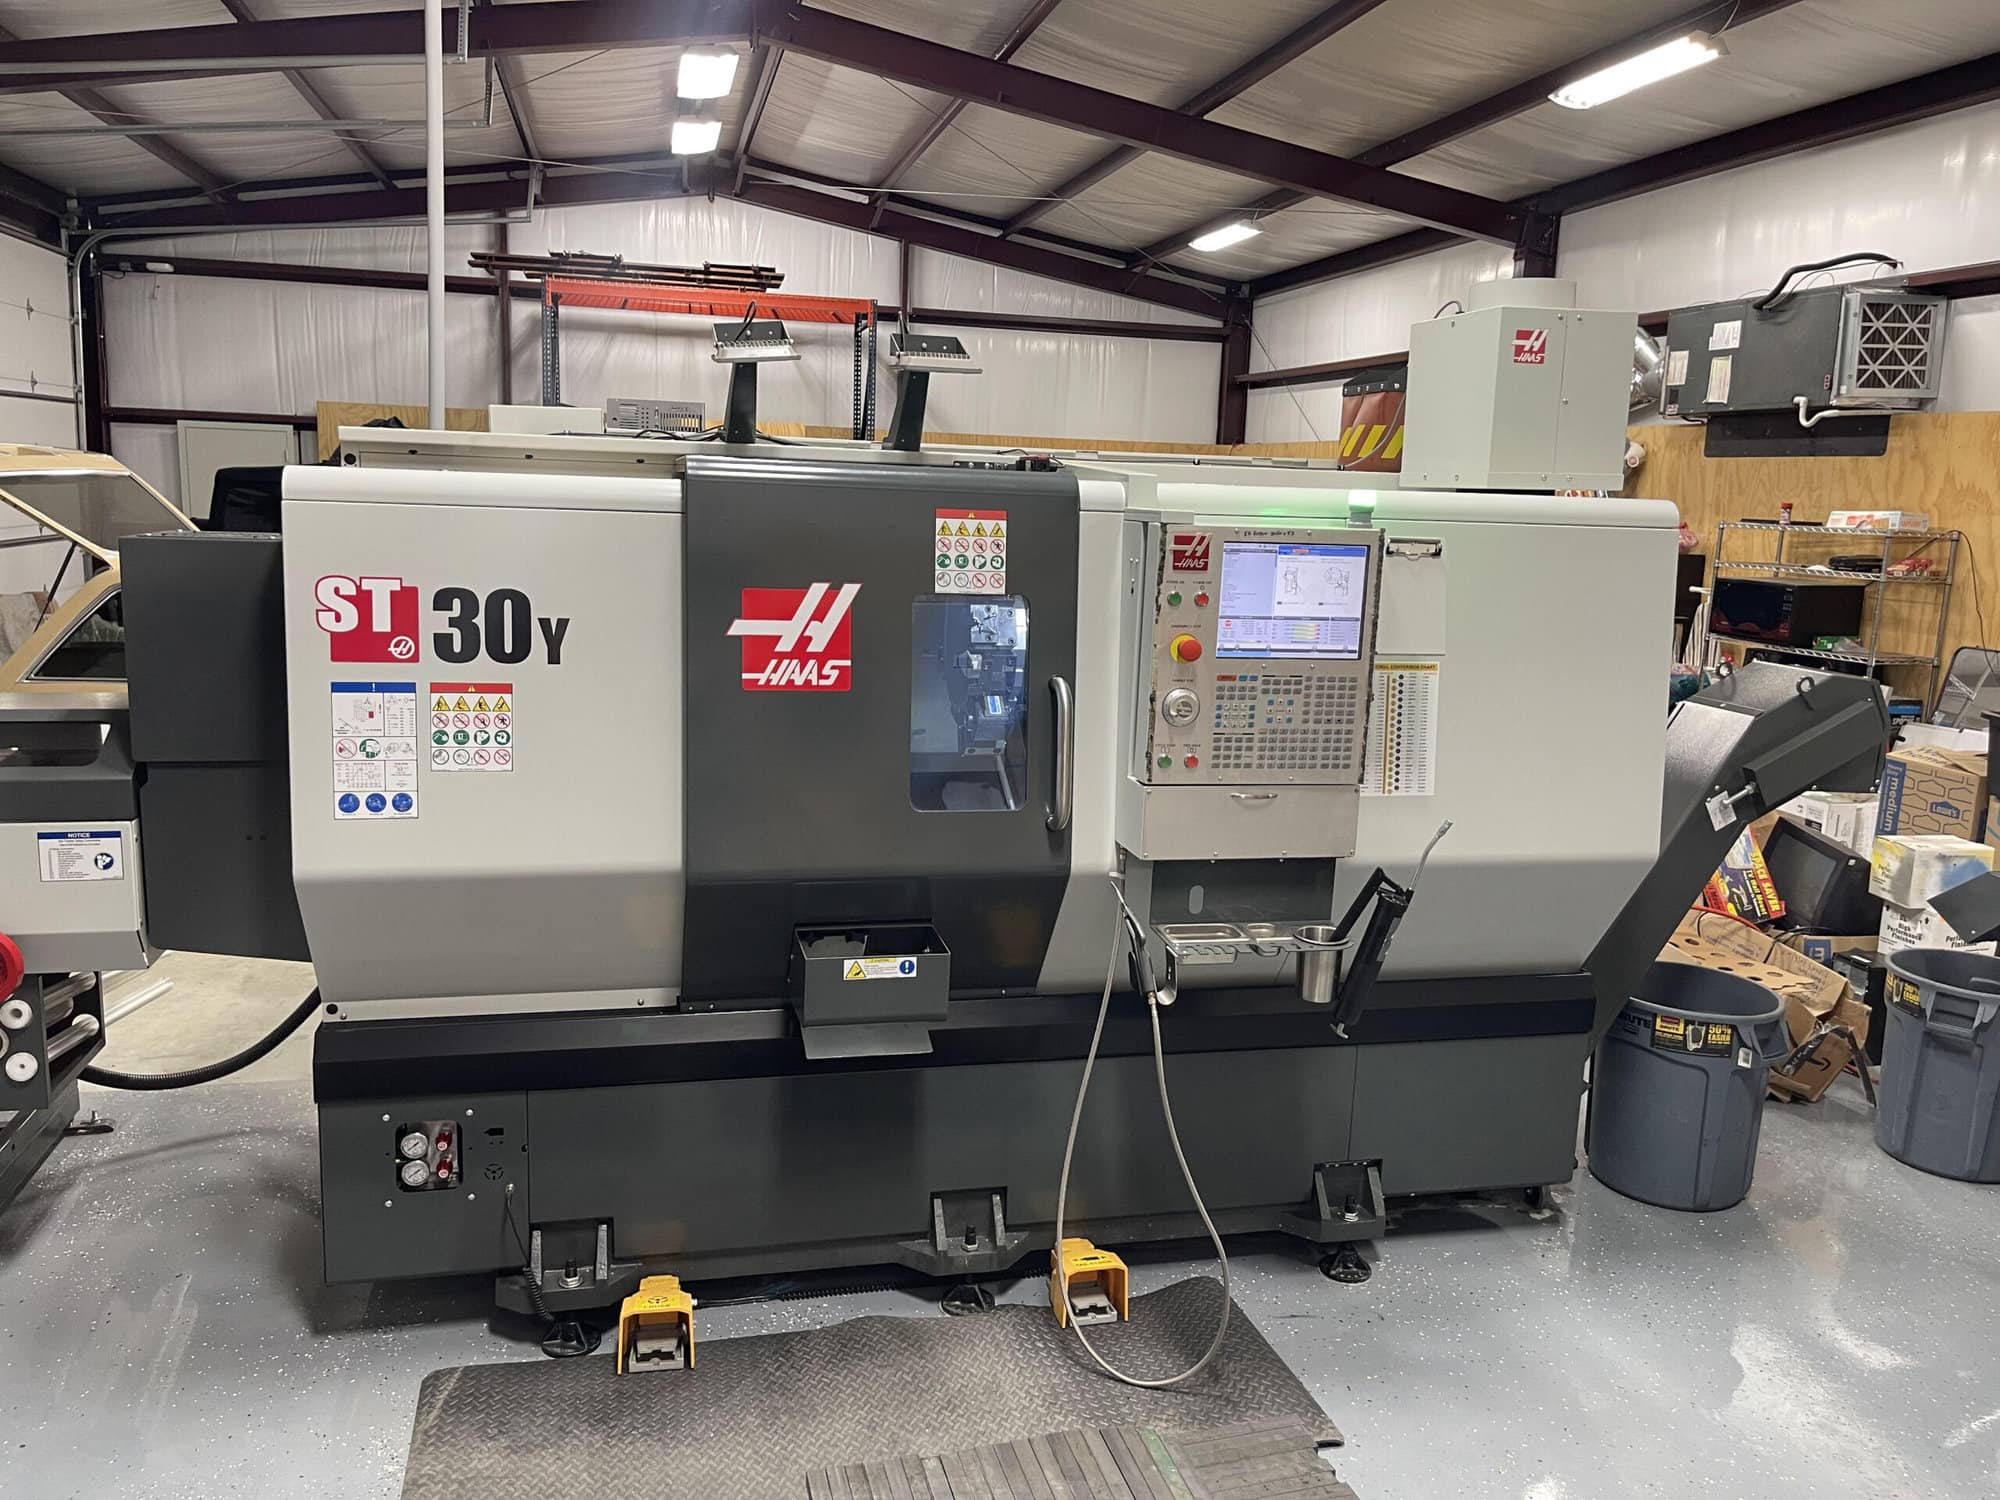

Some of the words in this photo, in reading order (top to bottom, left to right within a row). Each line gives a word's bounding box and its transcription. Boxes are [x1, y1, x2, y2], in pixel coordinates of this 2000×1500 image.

[1514, 352, 1545, 362] HAAS
[1174, 558, 1209, 568] HAAS
[315, 575, 403, 634] ST
[742, 659, 852, 686] HAAS
[1884, 777, 1900, 832] medium
[1751, 848, 1770, 881] SPACE
[1762, 882, 1782, 912] SAVER
[1708, 1023, 1732, 1034] 50%
